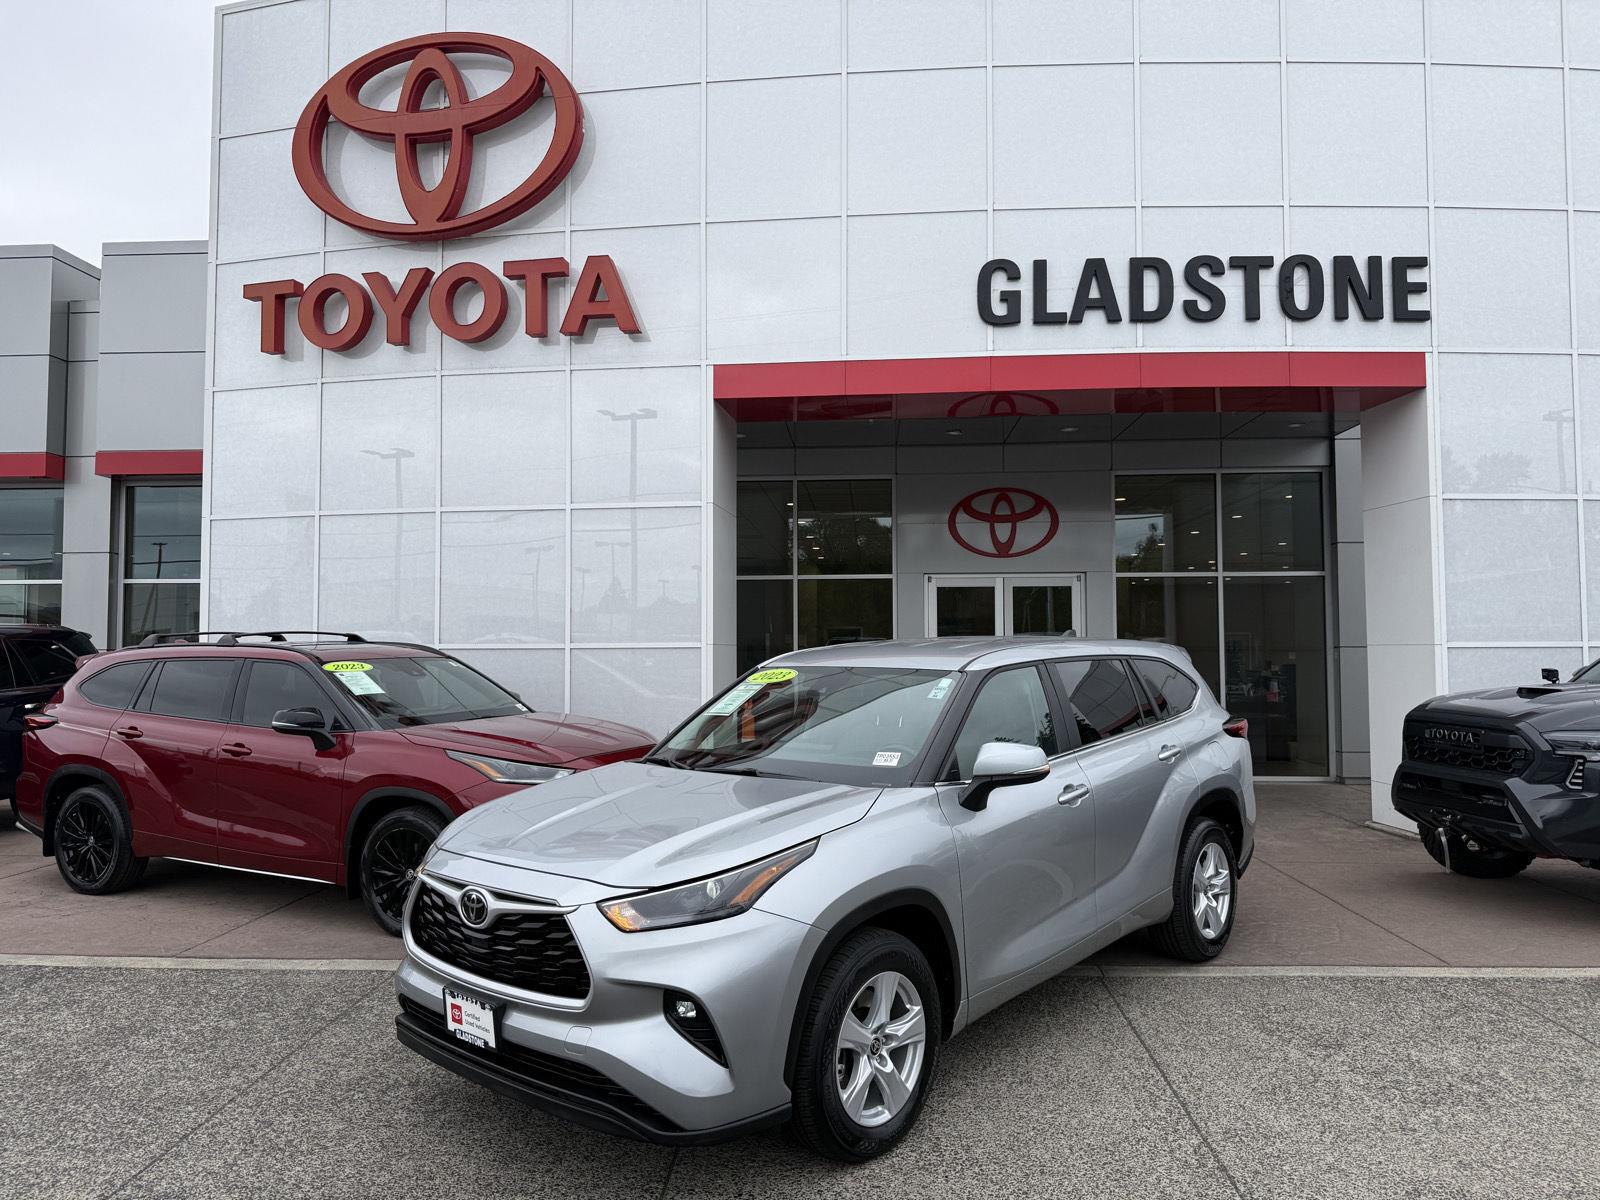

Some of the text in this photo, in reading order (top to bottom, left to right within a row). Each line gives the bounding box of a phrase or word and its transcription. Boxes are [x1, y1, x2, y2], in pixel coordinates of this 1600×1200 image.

[976, 254, 1431, 326] GLADSTONE
[242, 254, 642, 355] TOYOTA
[1431, 728, 1474, 743] TOYOTA
[464, 1010, 481, 1022] Certified
[464, 1019, 491, 1034] Used Vehicles
[456, 1029, 485, 1048] GLADSTONE
